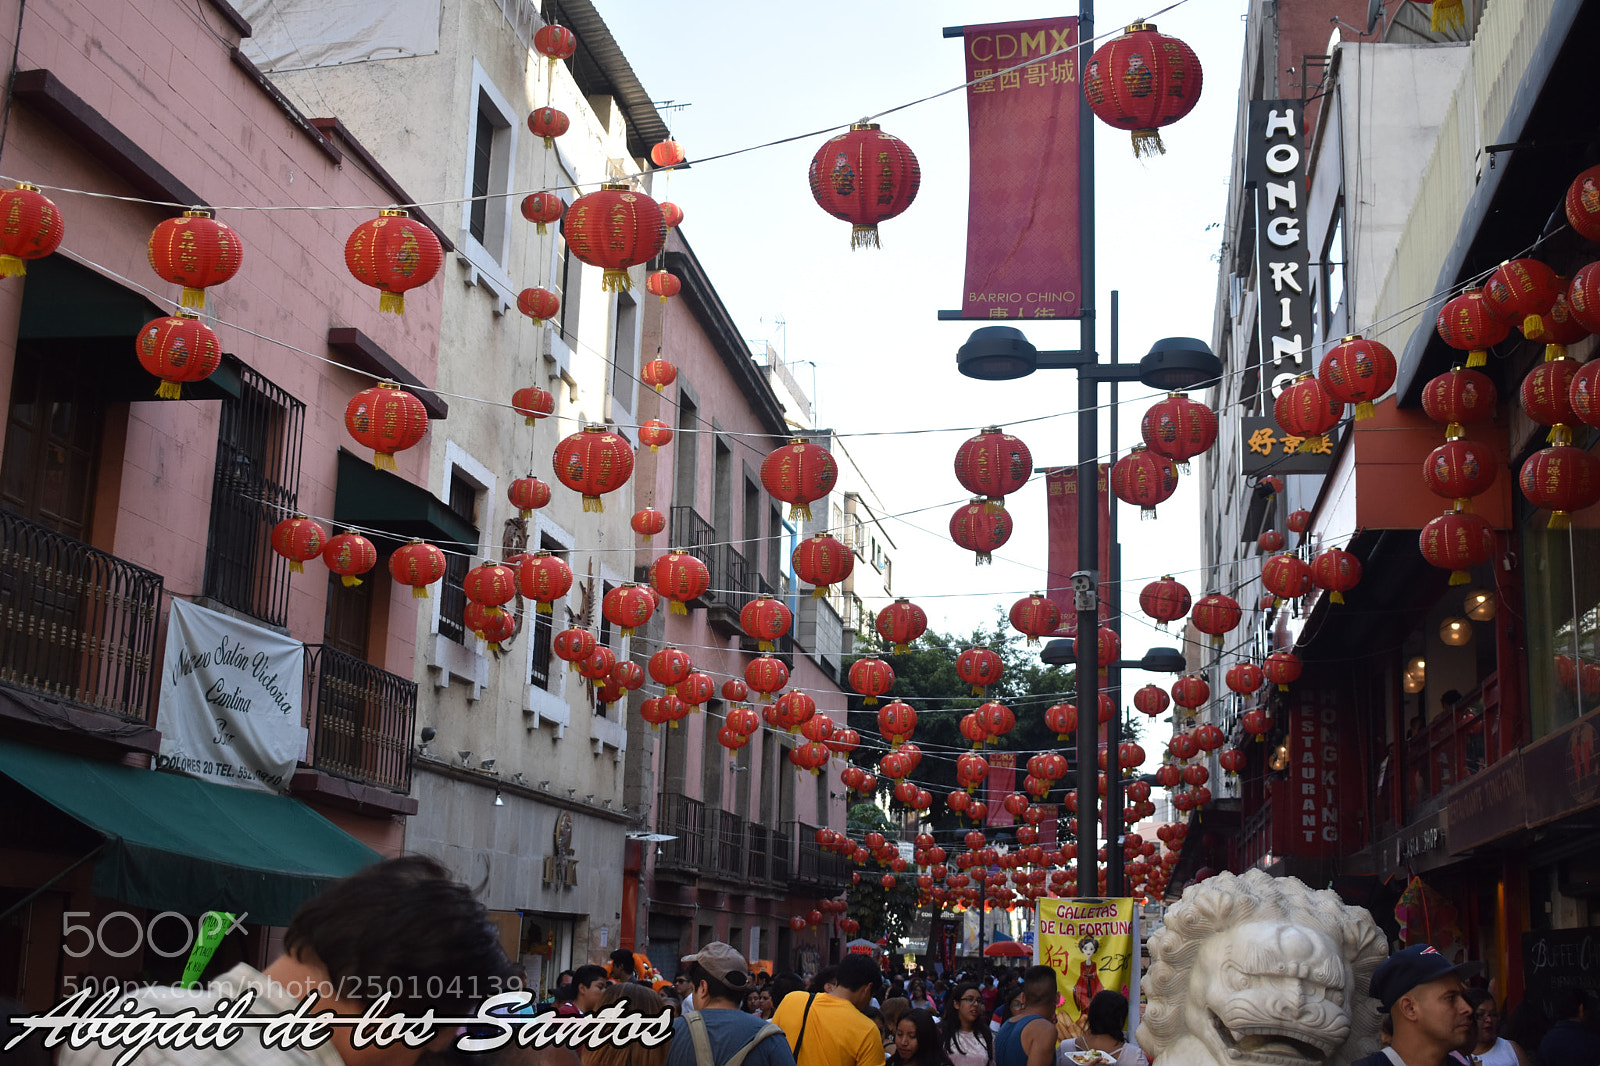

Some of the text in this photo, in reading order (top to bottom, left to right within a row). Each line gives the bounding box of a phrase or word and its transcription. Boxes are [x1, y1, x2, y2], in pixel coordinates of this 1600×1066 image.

[971, 28, 1072, 62] CDMX
[973, 60, 1075, 94] 墨西哥城
[1265, 108, 1300, 248] HONG
[968, 291, 1075, 304] BARRIO CHINO
[214, 635, 249, 671] Salón
[252, 652, 293, 715] Victoria
[205, 678, 252, 713] Cantina
[160, 754, 201, 773] DOLORES
[203, 761, 213, 775] 20
[215, 763, 235, 777] TEL.
[1301, 689, 1316, 843] RESTAURANT
[1320, 688, 1339, 843] HONG KING
[1040, 920, 1056, 934] DE
[1059, 922, 1075, 936] LA
[1056, 903, 1118, 920] GALLETAS
[1044, 944, 1069, 976] 狗
